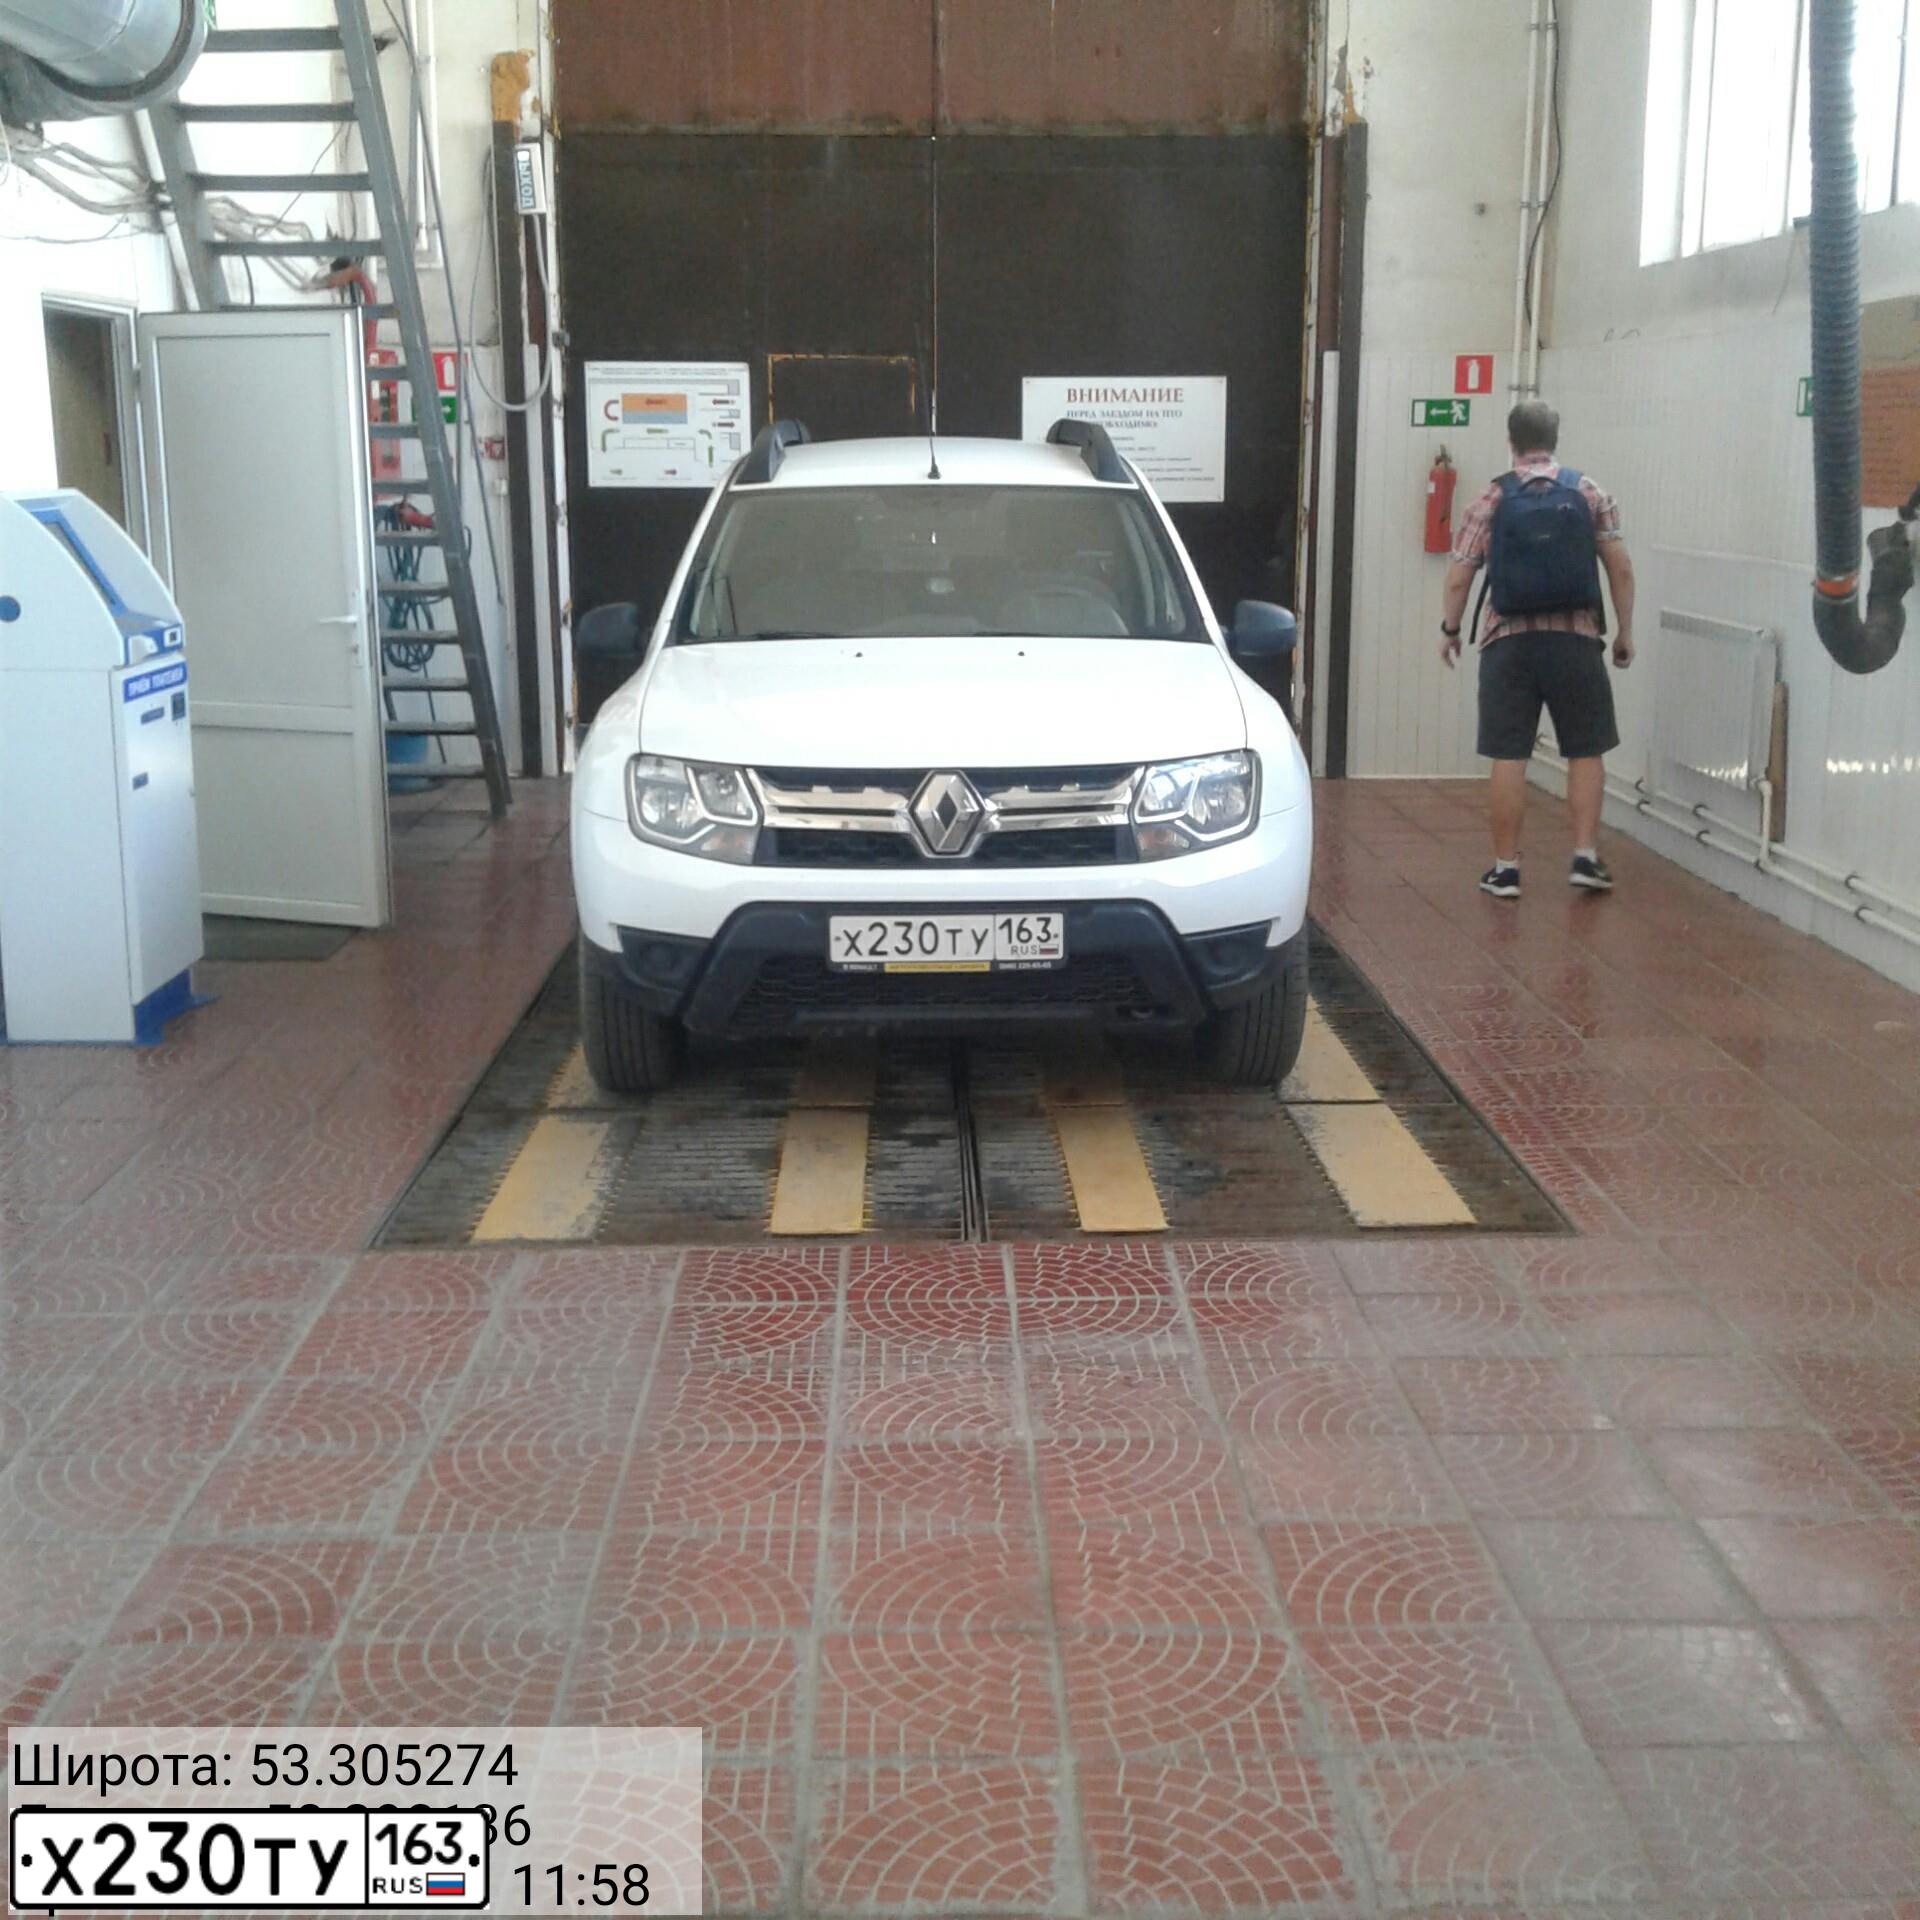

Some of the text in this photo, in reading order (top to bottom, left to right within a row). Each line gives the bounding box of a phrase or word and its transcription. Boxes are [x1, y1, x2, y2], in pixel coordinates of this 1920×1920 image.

[1066, 388, 1184, 403] ВНИМАНИЕ
[1146, 410, 1160, 418] НА
[998, 917, 1052, 944] 163
[1011, 945, 1037, 955] RUS
